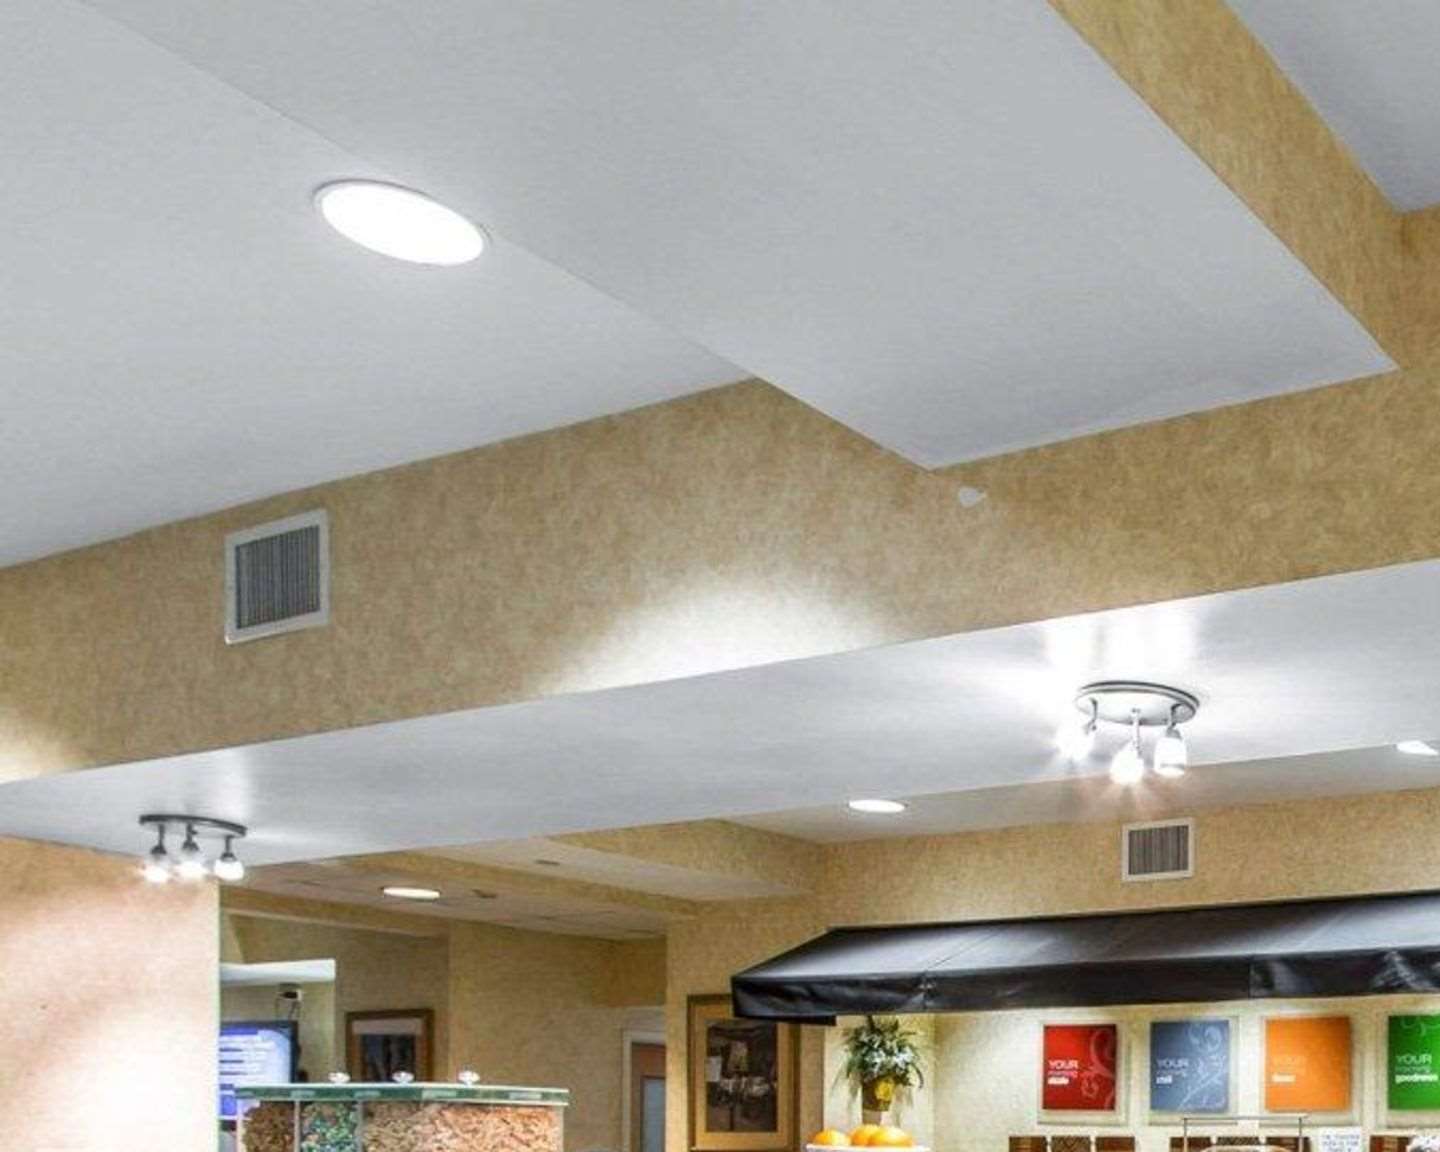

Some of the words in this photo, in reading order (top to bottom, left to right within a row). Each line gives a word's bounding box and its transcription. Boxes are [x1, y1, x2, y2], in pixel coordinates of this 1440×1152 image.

[1048, 1059, 1079, 1070] YOUR
[1156, 1057, 1189, 1070] YOUR
[1395, 1053, 1433, 1065] YOUR
